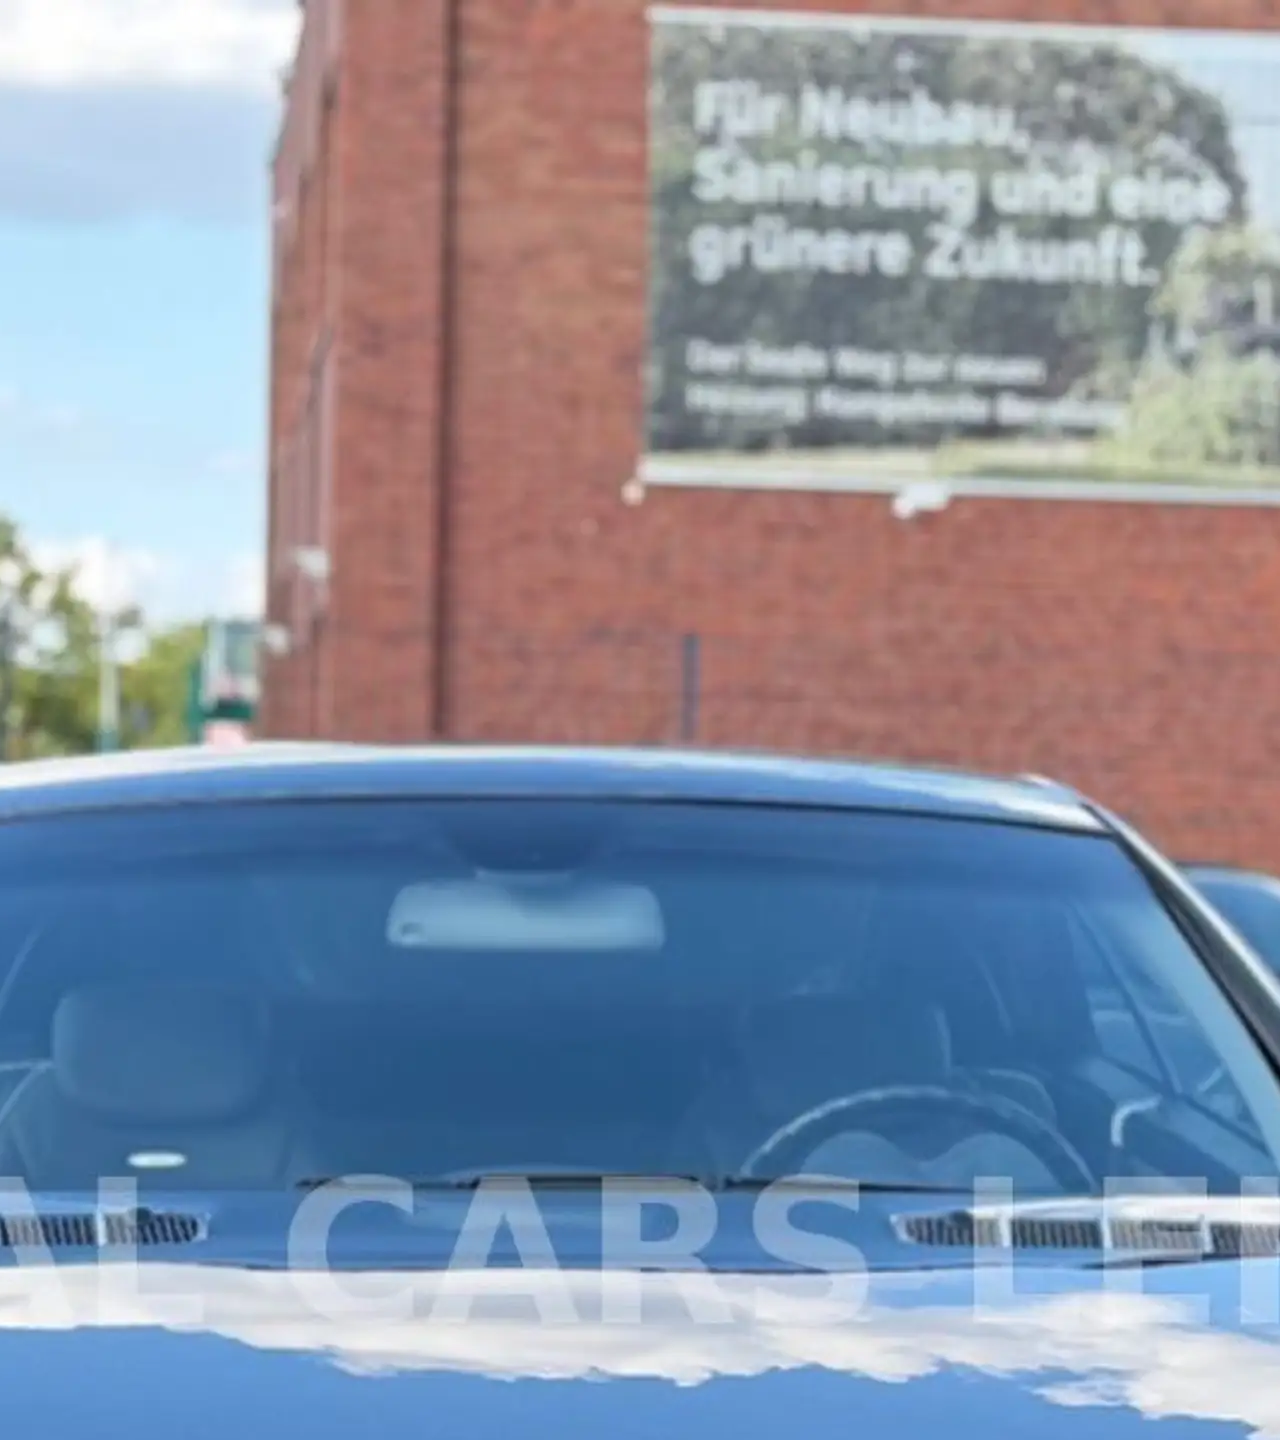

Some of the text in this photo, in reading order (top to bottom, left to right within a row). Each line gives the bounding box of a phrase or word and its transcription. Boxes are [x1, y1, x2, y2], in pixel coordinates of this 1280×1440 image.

[693, 79, 1030, 155] Für Neubau,
[691, 146, 978, 226] Sanierung
[991, 163, 1100, 218] und
[689, 211, 1161, 287] grünere Zukunft.
